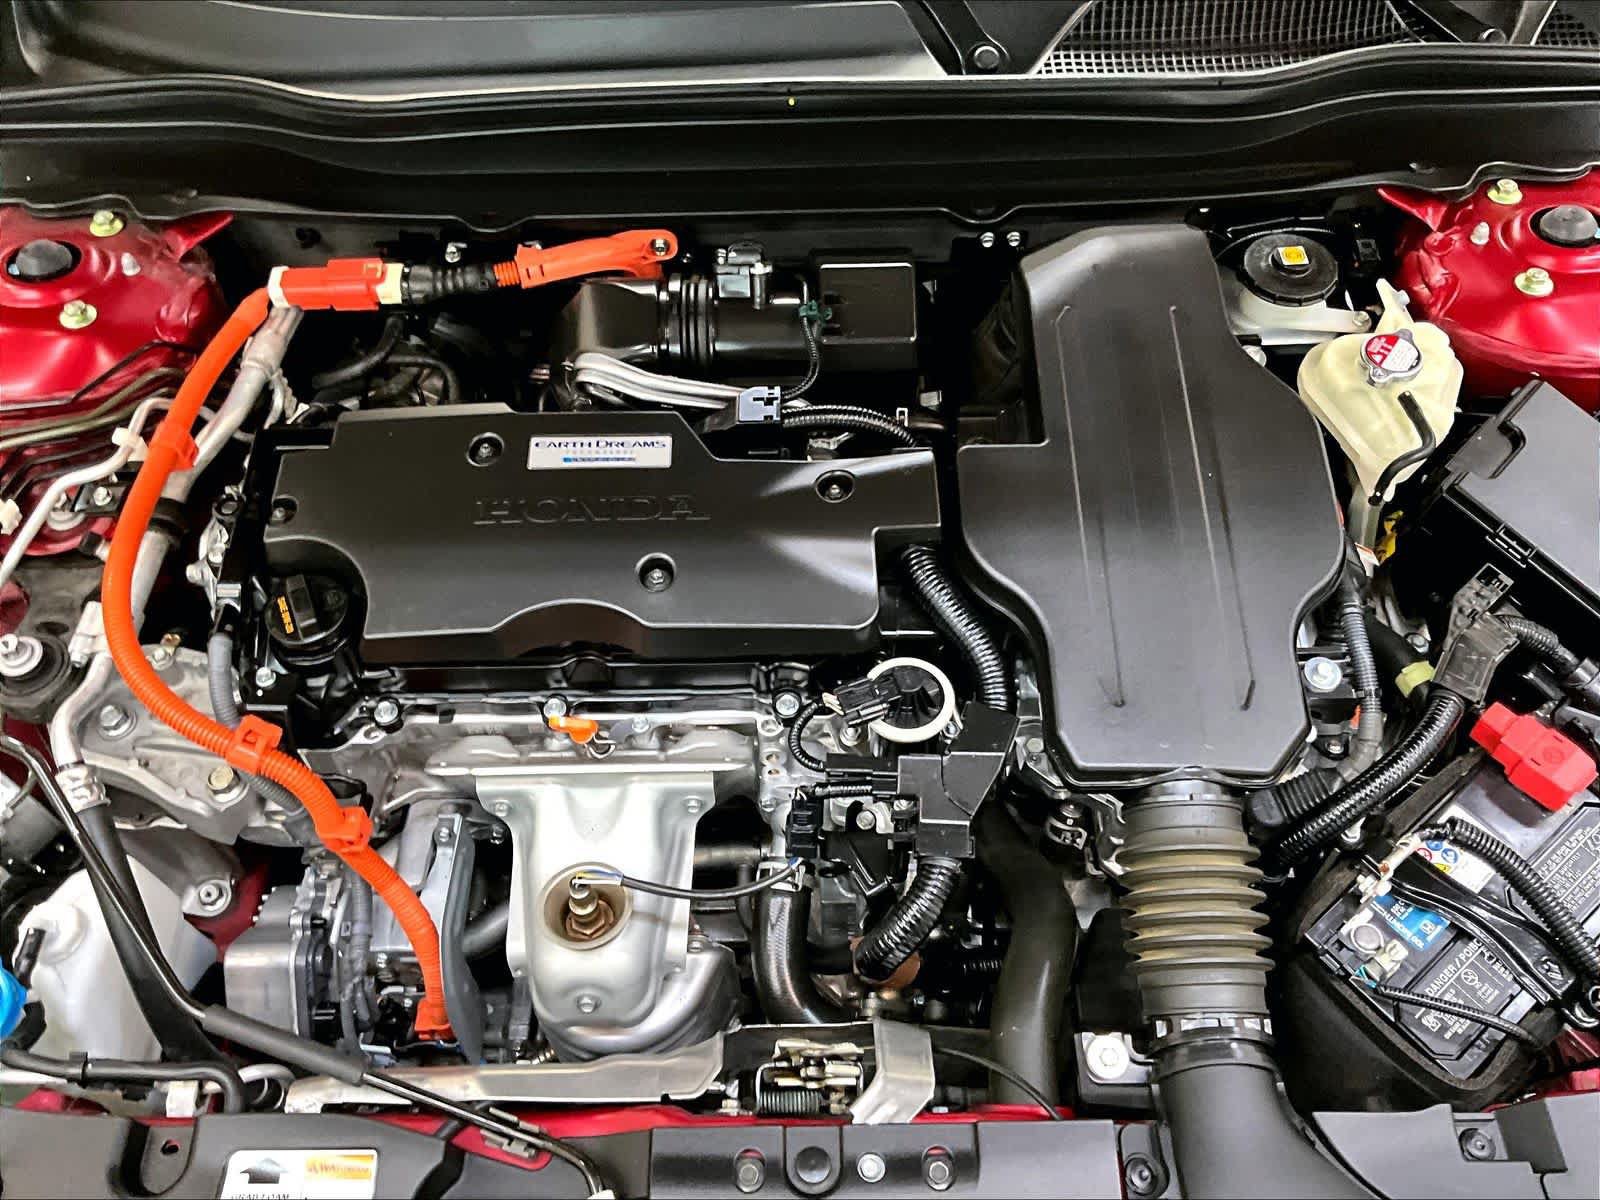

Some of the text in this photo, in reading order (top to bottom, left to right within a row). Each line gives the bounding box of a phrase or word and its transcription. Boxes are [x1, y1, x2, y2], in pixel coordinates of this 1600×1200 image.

[534, 439, 667, 448] EARTH DREAMS
[473, 495, 711, 524] HONDA
[1425, 964, 1458, 997] DANGER
[1459, 938, 1482, 962] POISO
